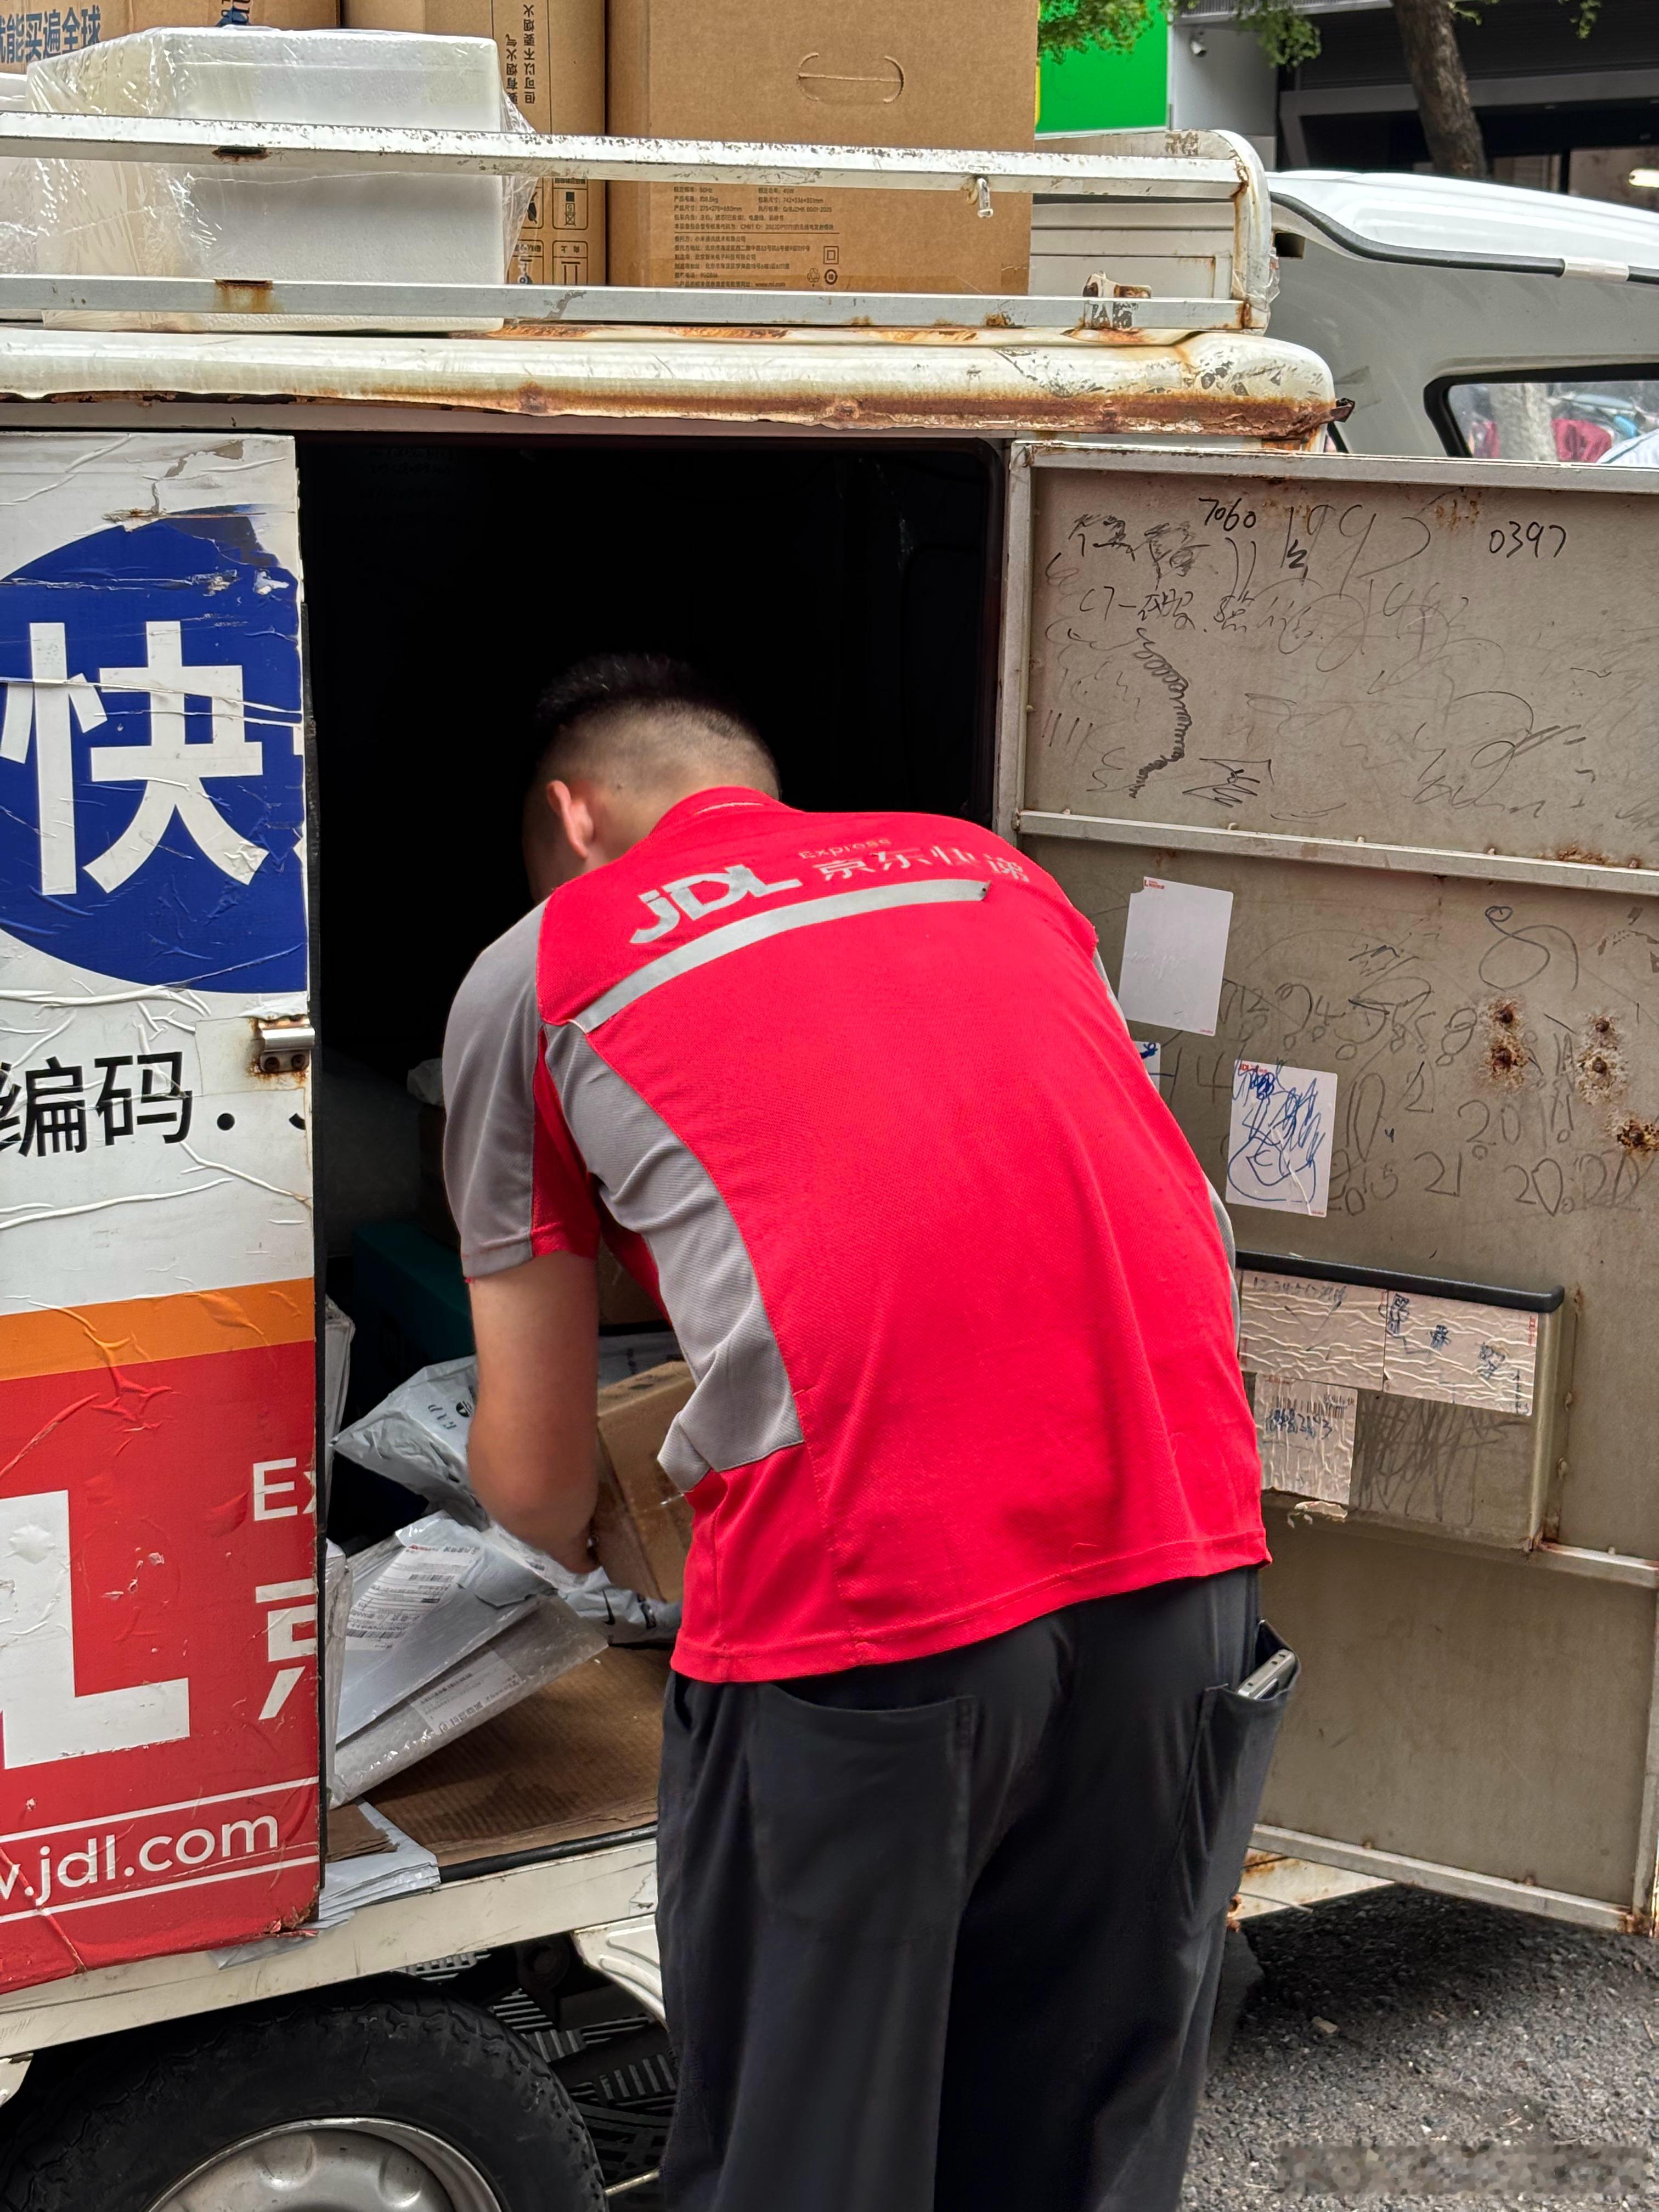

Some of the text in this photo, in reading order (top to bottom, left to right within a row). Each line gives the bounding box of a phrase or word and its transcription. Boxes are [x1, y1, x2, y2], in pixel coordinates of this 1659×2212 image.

[522, 4, 536, 104] 但可以不要烟火
[1198, 498, 1257, 532] 7060
[1489, 521, 1567, 558] 0397
[0, 620, 269, 895] 快
[629, 864, 804, 944] JDL
